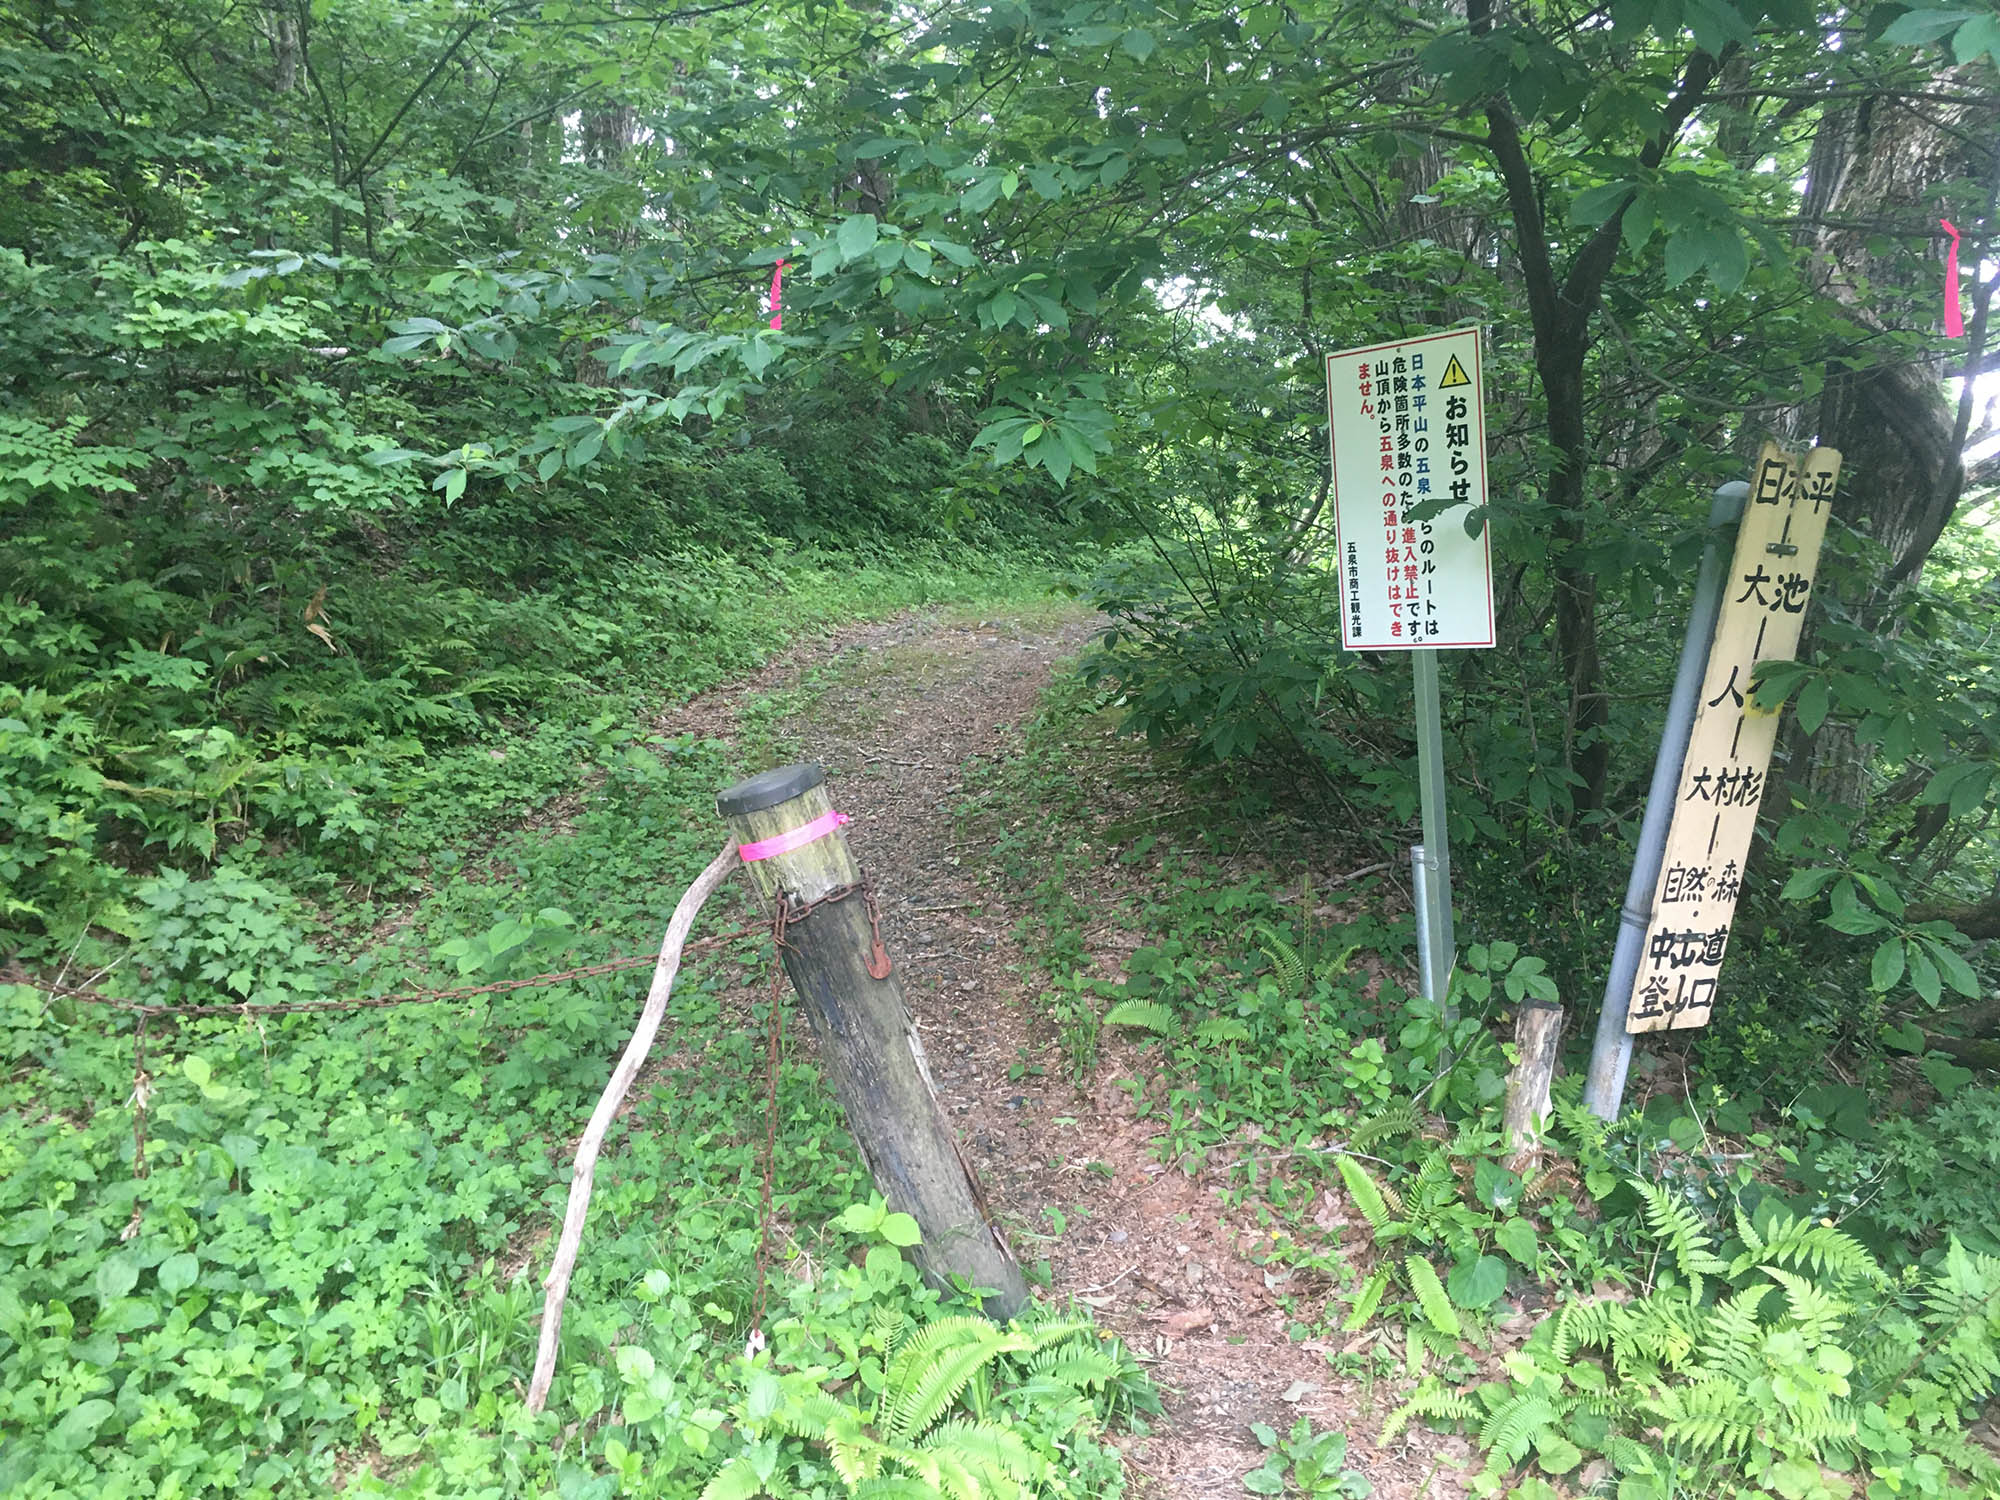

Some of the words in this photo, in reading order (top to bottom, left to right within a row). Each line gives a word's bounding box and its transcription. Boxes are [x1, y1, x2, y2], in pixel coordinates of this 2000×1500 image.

[1358, 363, 1375, 420] ません。
[1446, 395, 1471, 502] お知らせ
[1375, 360, 1402, 637] 山頂から五泉への通り抜けはでき
[1411, 353, 1439, 636] 日本平山の五泉らのルートは
[1756, 458, 1834, 514] 日本平
[1347, 542, 1362, 638] 五泉市商工観光課
[1736, 564, 1810, 613] 大池
[1708, 665, 1766, 708] 人
[1685, 766, 1763, 808] 大村杉
[1661, 859, 1740, 904] 自然の森
[1634, 974, 1717, 1019] 登山口
